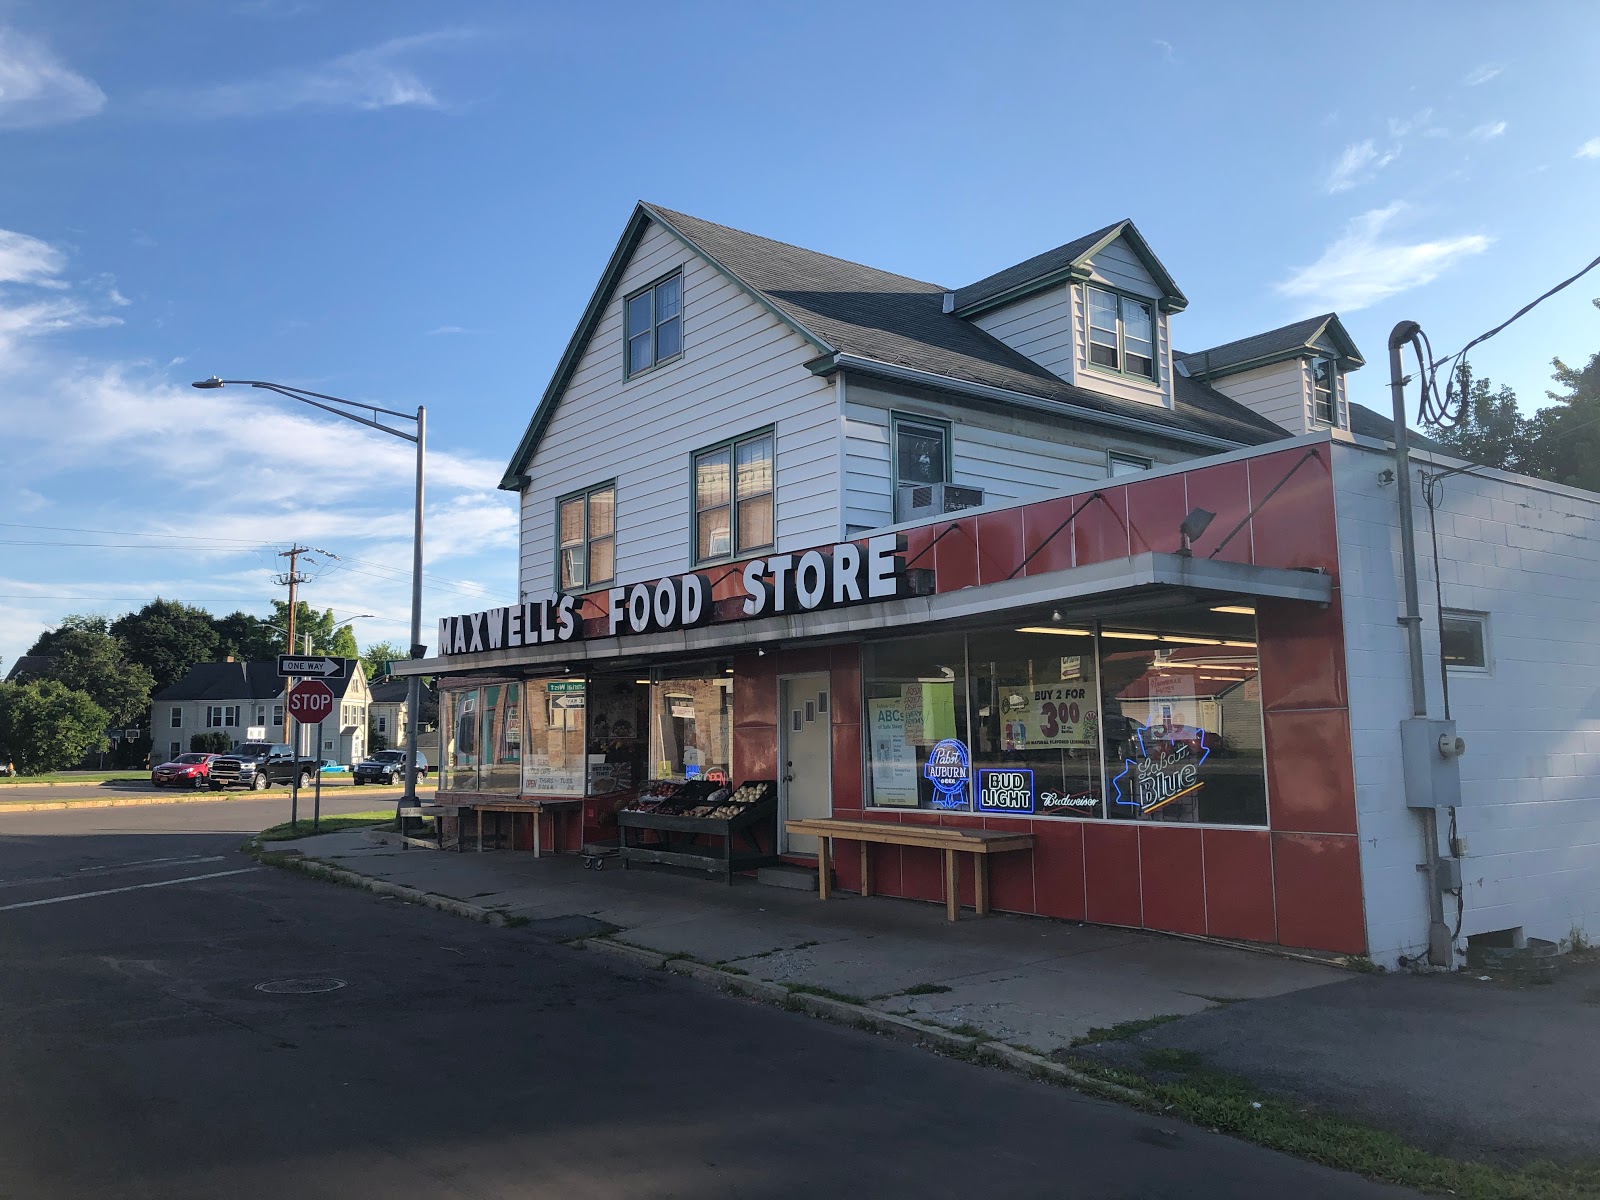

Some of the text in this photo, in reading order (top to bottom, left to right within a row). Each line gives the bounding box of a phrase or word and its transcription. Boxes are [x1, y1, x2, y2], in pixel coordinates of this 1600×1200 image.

[438, 534, 898, 655] MAXWELL'S FOOD STORE
[308, 662, 324, 670] WAY
[291, 694, 330, 710] STOP
[1034, 689, 1086, 700] BUY 2 FOR
[878, 710, 905, 722] ABCs
[935, 748, 960, 764] Pabst
[1138, 743, 1189, 780] Labatt
[930, 766, 966, 778] AUBURN
[988, 773, 1025, 790] BUD
[1139, 764, 1197, 810] Blue
[981, 789, 1031, 808] LIGHT
[1040, 792, 1099, 807] Budweiser
